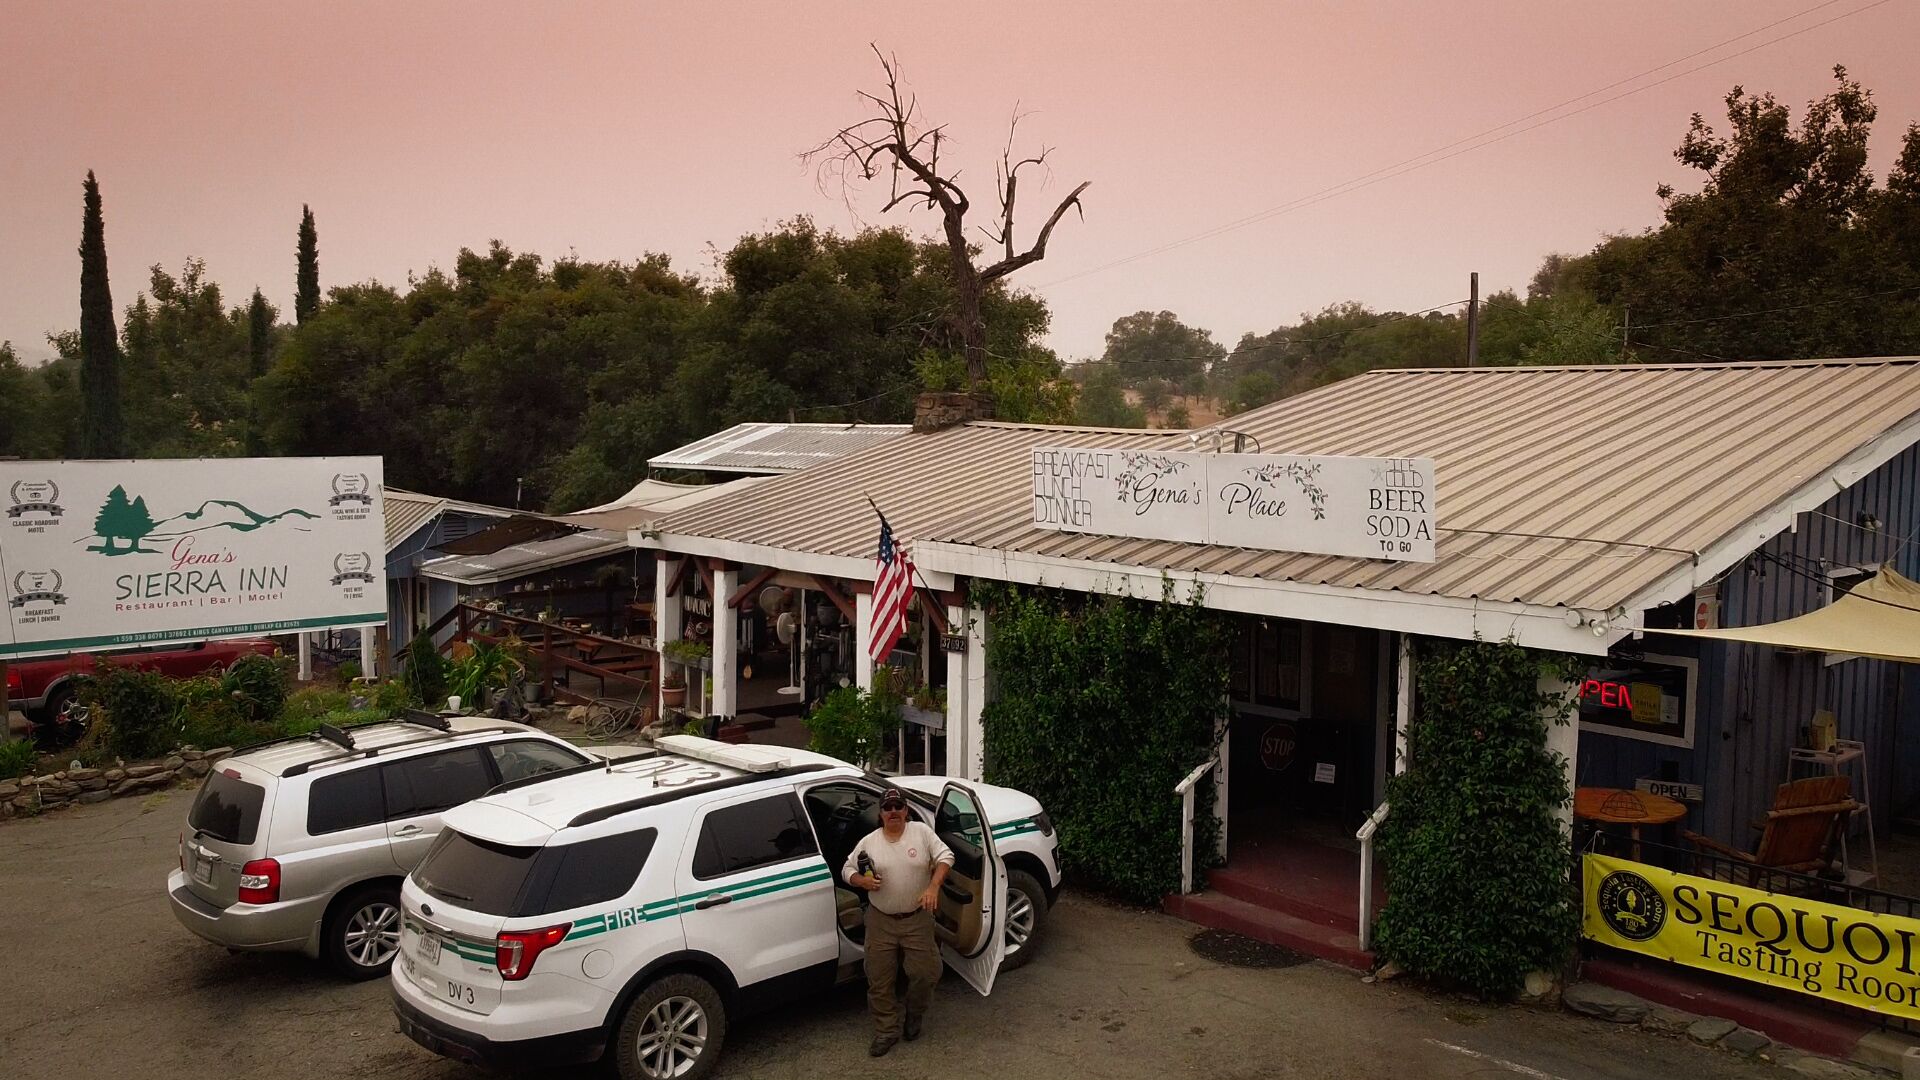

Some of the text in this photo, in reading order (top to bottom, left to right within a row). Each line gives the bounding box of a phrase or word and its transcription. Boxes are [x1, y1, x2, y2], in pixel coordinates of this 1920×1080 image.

[1034, 451, 1112, 479] BREAKFAST
[1034, 476, 1082, 501] LUNCH
[1132, 472, 1288, 519] Gena's Place
[1369, 488, 1427, 513] BEER
[1035, 494, 1092, 526] DINNER
[1366, 514, 1432, 541] SODA
[170, 536, 238, 570] Gena's
[1380, 540, 1412, 552] TO GO
[116, 566, 288, 600] SIERRA INN
[116, 599, 193, 612] Restaurant
[210, 596, 232, 605] Bar
[248, 592, 284, 602] Motel
[1580, 680, 1632, 710] PEN
[1264, 737, 1296, 756] STOP
[1650, 782, 1687, 798] OPEN
[604, 906, 647, 931] FIRE
[1672, 886, 1920, 976] SEQUOI
[1696, 930, 1822, 992] Tasting
[448, 981, 474, 1004] DV 3
